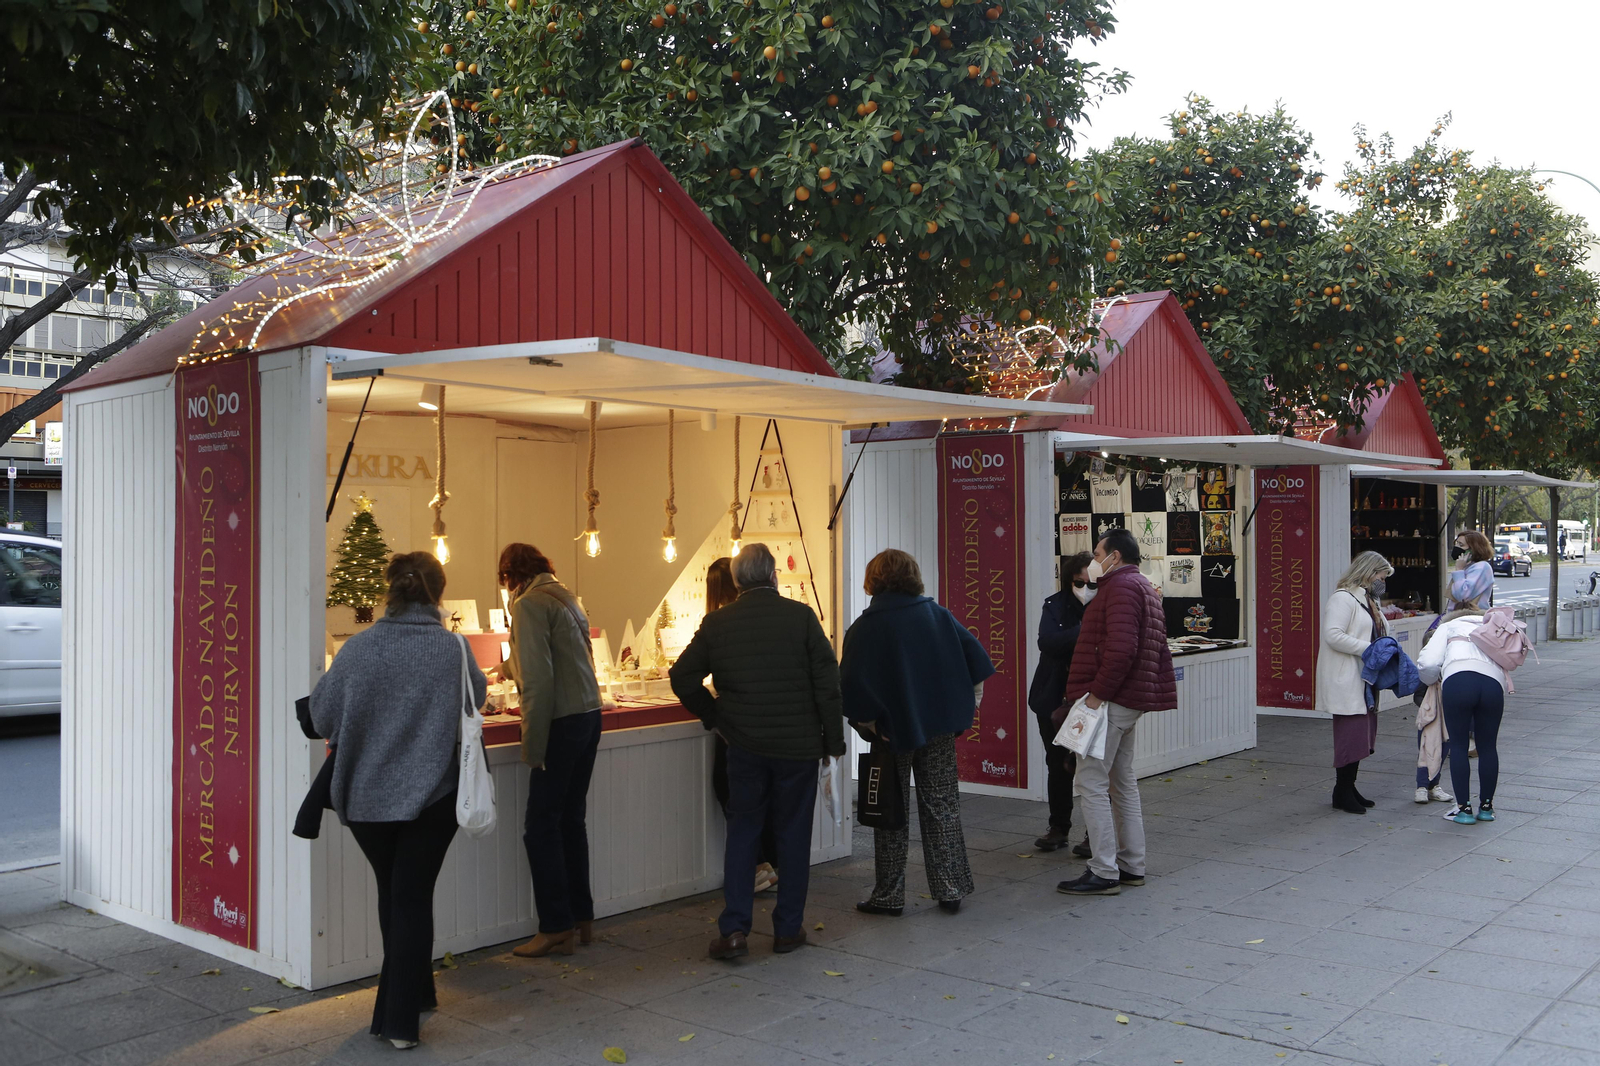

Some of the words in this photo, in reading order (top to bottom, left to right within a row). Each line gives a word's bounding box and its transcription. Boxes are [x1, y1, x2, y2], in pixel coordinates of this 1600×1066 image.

[198, 444, 213, 453] Distrito
[199, 467, 216, 666] NAVIDEÑO
[962, 498, 980, 621] NAVIDEÑO
[1062, 523, 1089, 532] adobo
[1269, 508, 1283, 594] NAVIDEÑO
[986, 568, 1005, 675] NERVIÓN
[1271, 598, 1283, 680] MERCADO
[1287, 558, 1304, 632] NERVIÓN
[222, 582, 239, 758] NERVIÓN
[199, 674, 214, 869] MERCADO
